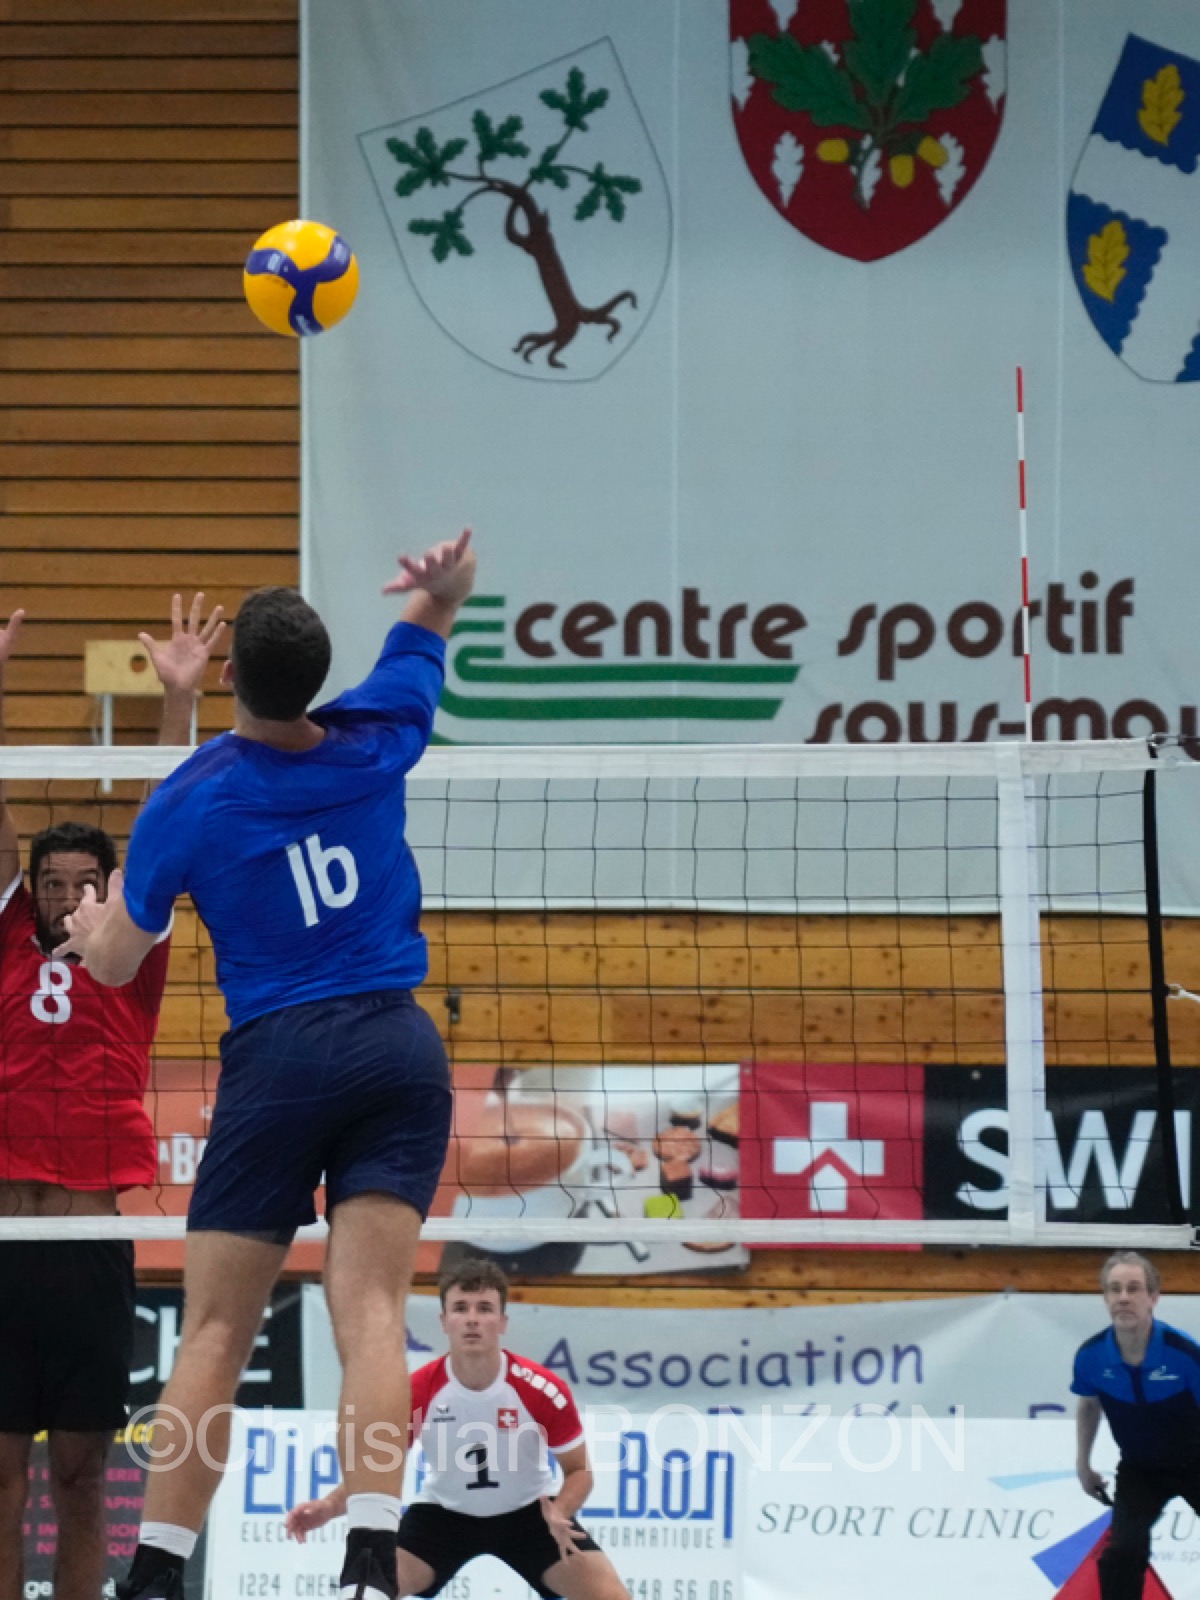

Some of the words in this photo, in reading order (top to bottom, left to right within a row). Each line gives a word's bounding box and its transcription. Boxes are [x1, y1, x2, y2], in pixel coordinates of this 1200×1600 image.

[514, 587, 808, 660] centre
[837, 570, 1135, 681] sportif
[285, 832, 360, 928] 16
[30, 961, 73, 1024] 8
[545, 1336, 923, 1391] Association
[465, 1443, 500, 1490] 1
[757, 1502, 894, 1537] SPORT
[908, 1506, 1055, 1541] CLINIC
[238, 1573, 280, 1597] 1224
